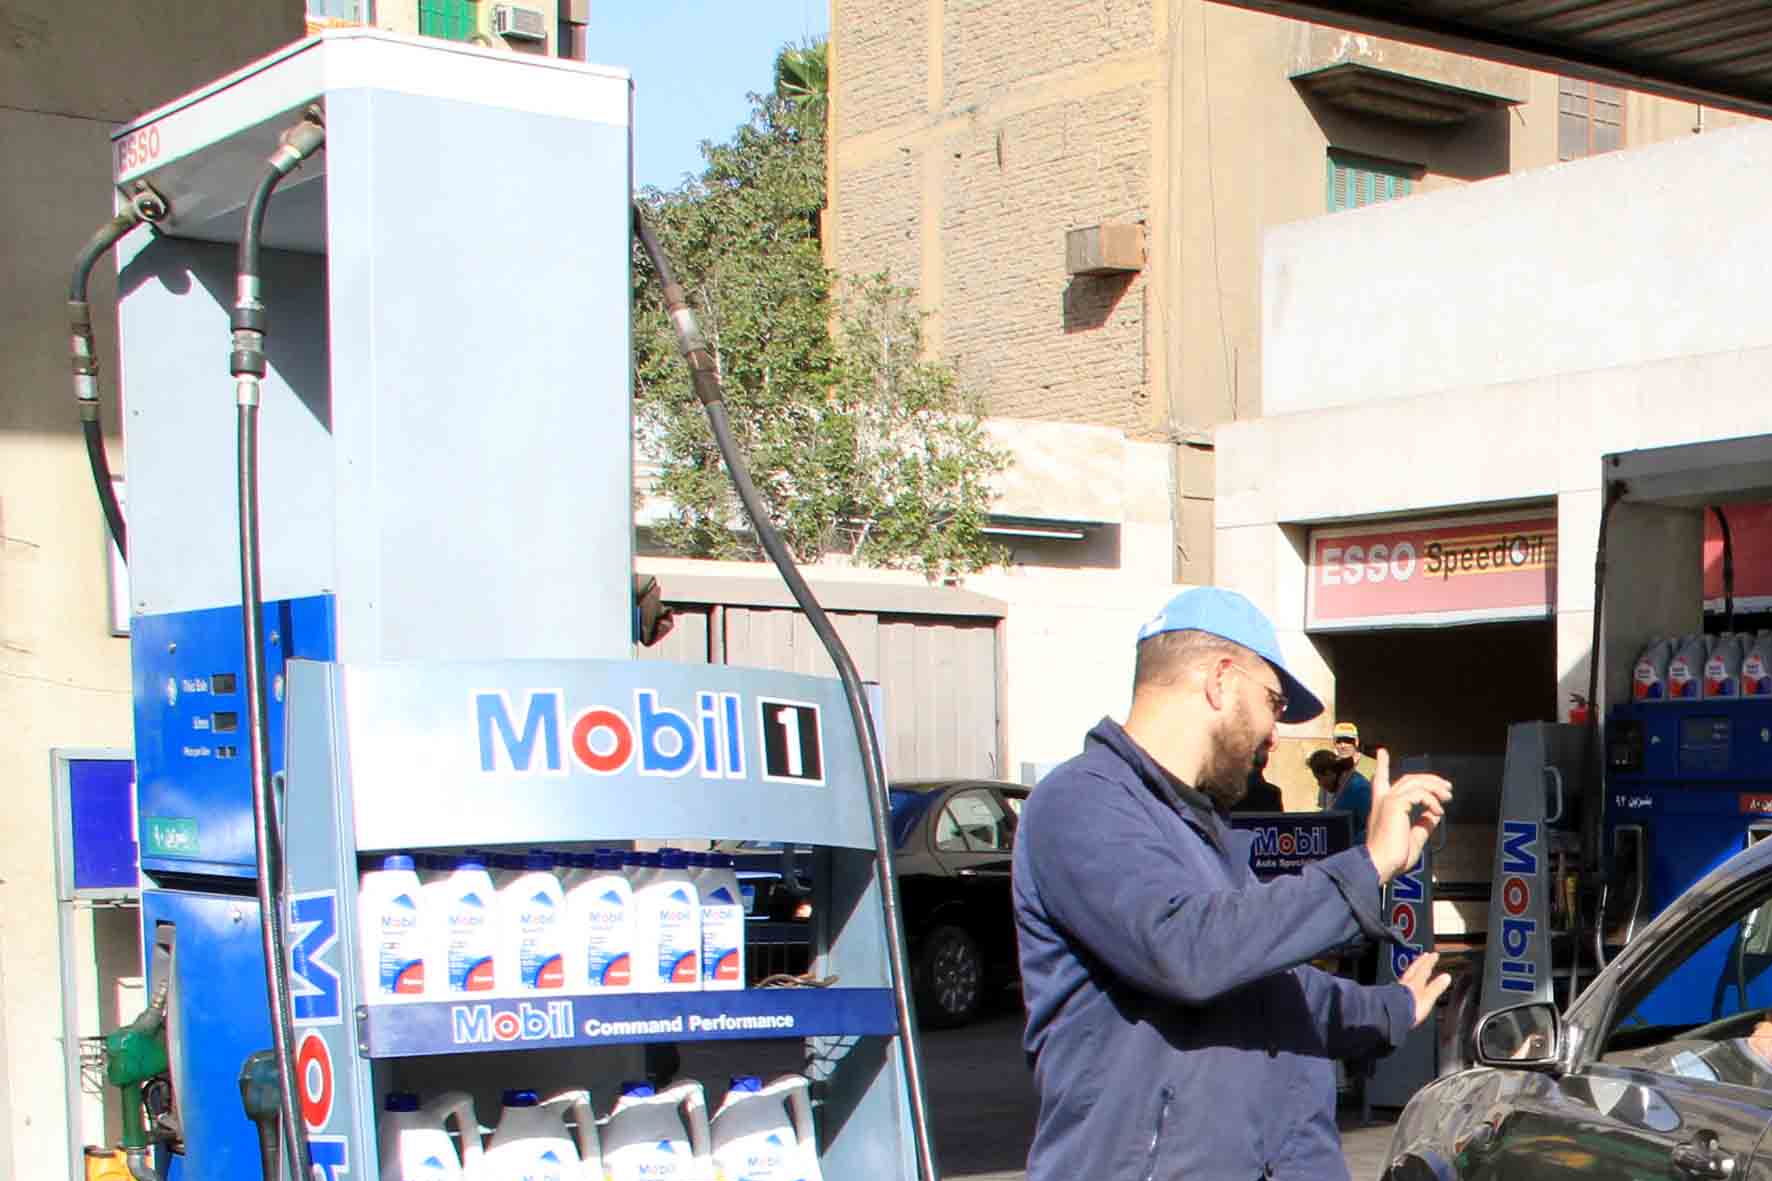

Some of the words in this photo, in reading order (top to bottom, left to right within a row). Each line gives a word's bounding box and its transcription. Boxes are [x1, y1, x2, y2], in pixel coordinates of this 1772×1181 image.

[119, 126, 160, 172] ESSO
[1321, 541, 1417, 585] ESSO
[1425, 535, 1544, 581] SpeedOil
[470, 690, 744, 777] Mobil
[1253, 826, 1328, 856] Mobil
[1391, 848, 1425, 980] Mob
[1499, 820, 1538, 993] Mobil
[452, 1001, 574, 1044] Mobil
[584, 1015, 683, 1038] Command
[688, 1012, 795, 1032] Performance
